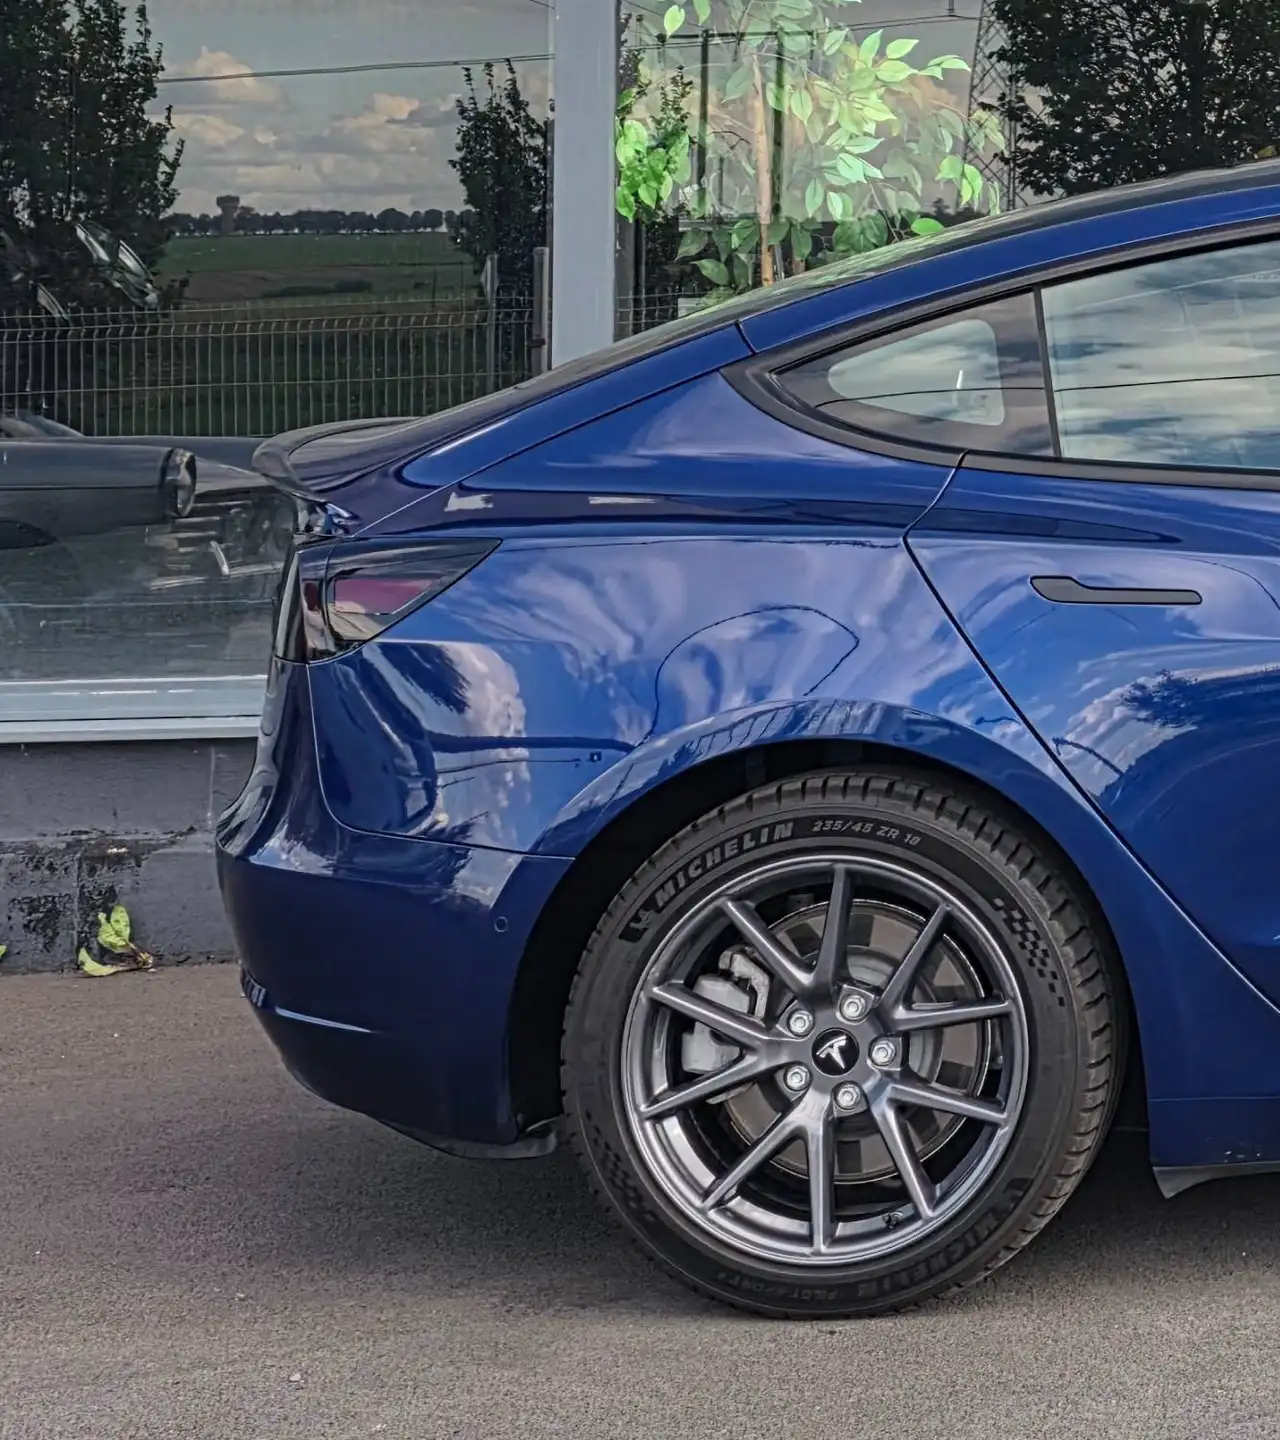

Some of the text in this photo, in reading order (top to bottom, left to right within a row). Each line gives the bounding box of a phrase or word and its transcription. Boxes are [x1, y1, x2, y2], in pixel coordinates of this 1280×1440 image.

[655, 820, 795, 908] MICHELIN
[811, 819, 874, 836] 235/45
[876, 826, 900, 841] ZR
